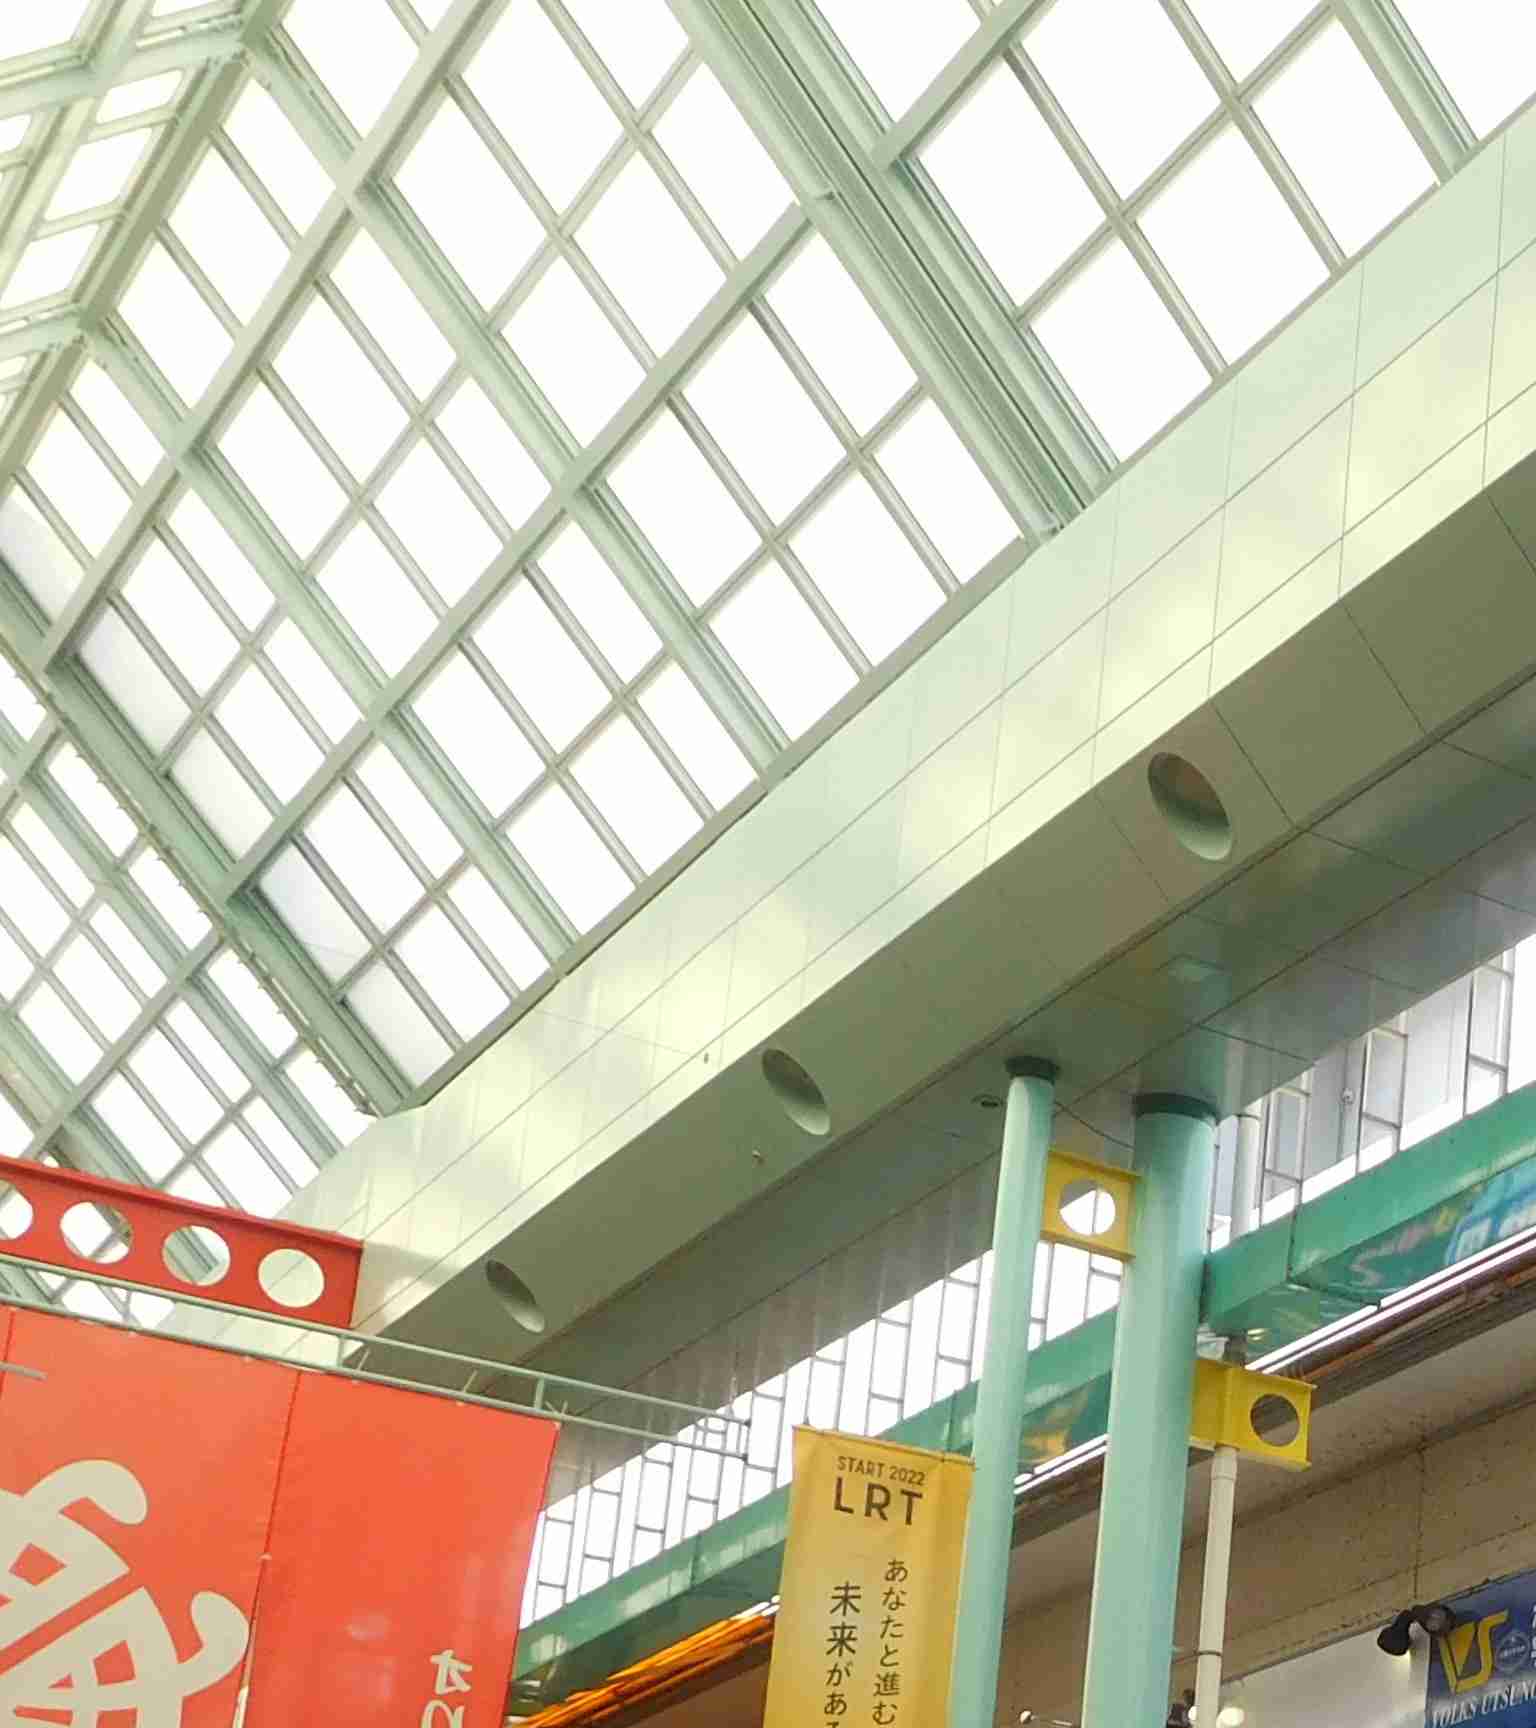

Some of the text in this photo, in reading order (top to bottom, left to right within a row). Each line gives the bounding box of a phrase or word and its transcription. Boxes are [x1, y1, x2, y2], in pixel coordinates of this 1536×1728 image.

[837, 1455, 925, 1486] START 2022
[833, 1477, 923, 1527] LRT
